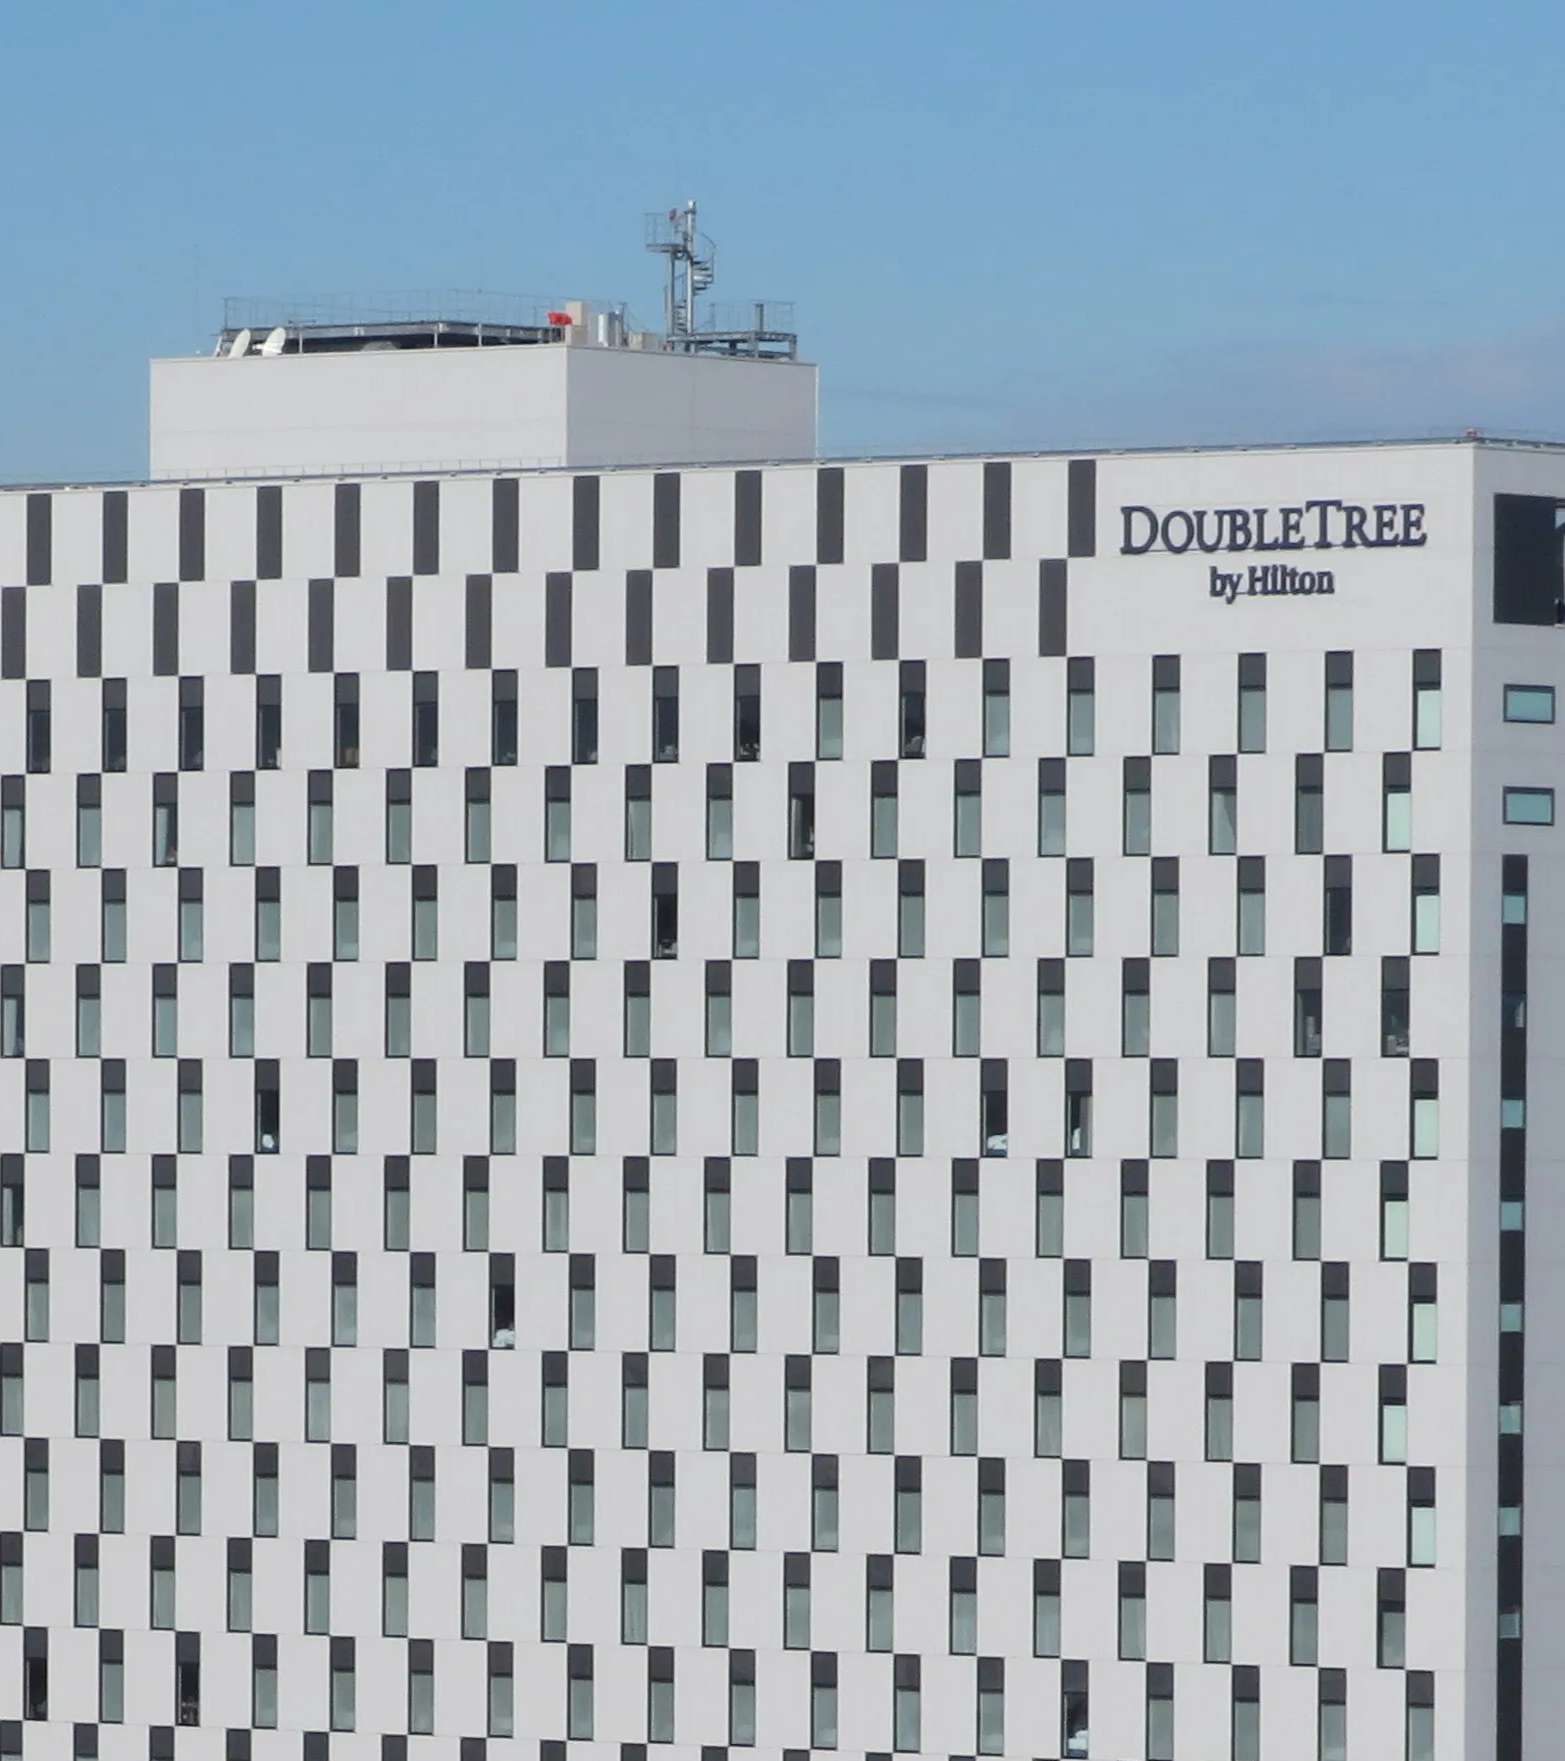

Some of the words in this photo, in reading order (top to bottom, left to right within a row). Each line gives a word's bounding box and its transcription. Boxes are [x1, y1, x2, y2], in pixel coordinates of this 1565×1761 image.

[1120, 500, 1427, 554] DOUBLETREE
[1209, 565, 1243, 604] by
[1247, 563, 1335, 595] Hilton
